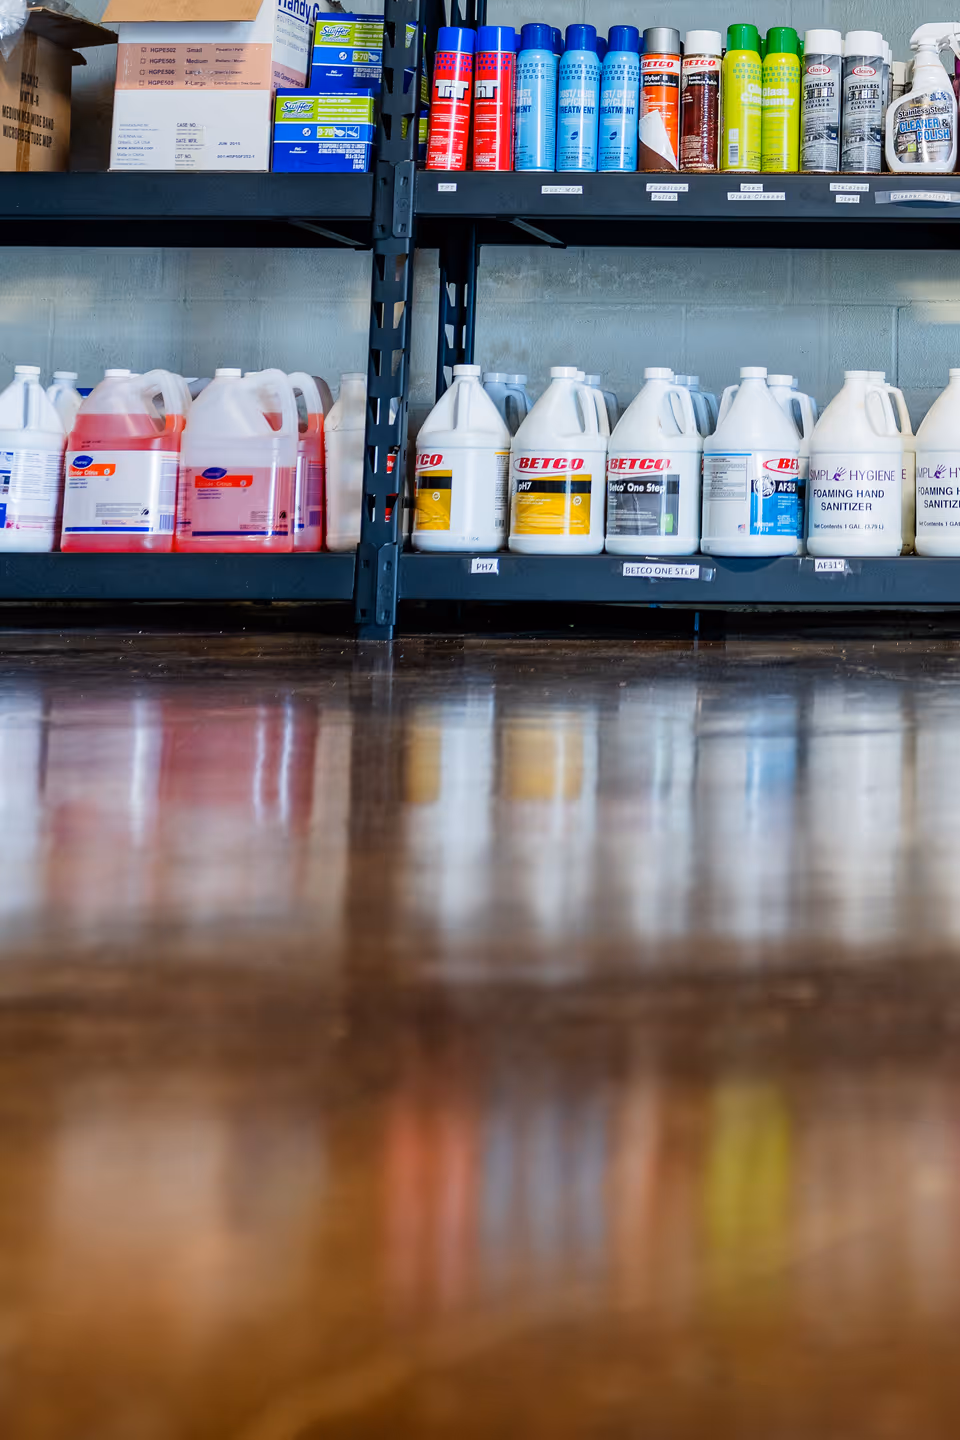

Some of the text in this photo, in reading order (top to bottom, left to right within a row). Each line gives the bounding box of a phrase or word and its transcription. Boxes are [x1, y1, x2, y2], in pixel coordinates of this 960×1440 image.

[320, 24, 351, 36] Swiffer
[642, 60, 674, 68] BETCO
[810, 66, 826, 74] claire
[436, 80, 469, 99] TnT
[804, 88, 834, 100] STEEL
[848, 90, 879, 101] STEEL
[282, 100, 314, 112] Swiffer
[898, 108, 929, 118] Stainless
[900, 118, 948, 134] CLEANER &
[318, 128, 334, 136] 3-70
[918, 130, 950, 142] POLISH
[519, 458, 584, 469] BETCO
[610, 458, 671, 470] BETCO
[850, 470, 896, 482] HYGIENE
[518, 482, 532, 492] pH7
[628, 483, 644, 492] One
[646, 482, 666, 494] Step
[918, 486, 953, 496] FOAMING
[814, 489, 884, 498] FOAMING HAND
[821, 502, 872, 512] SANITIZER
[626, 566, 652, 574] BETCO
